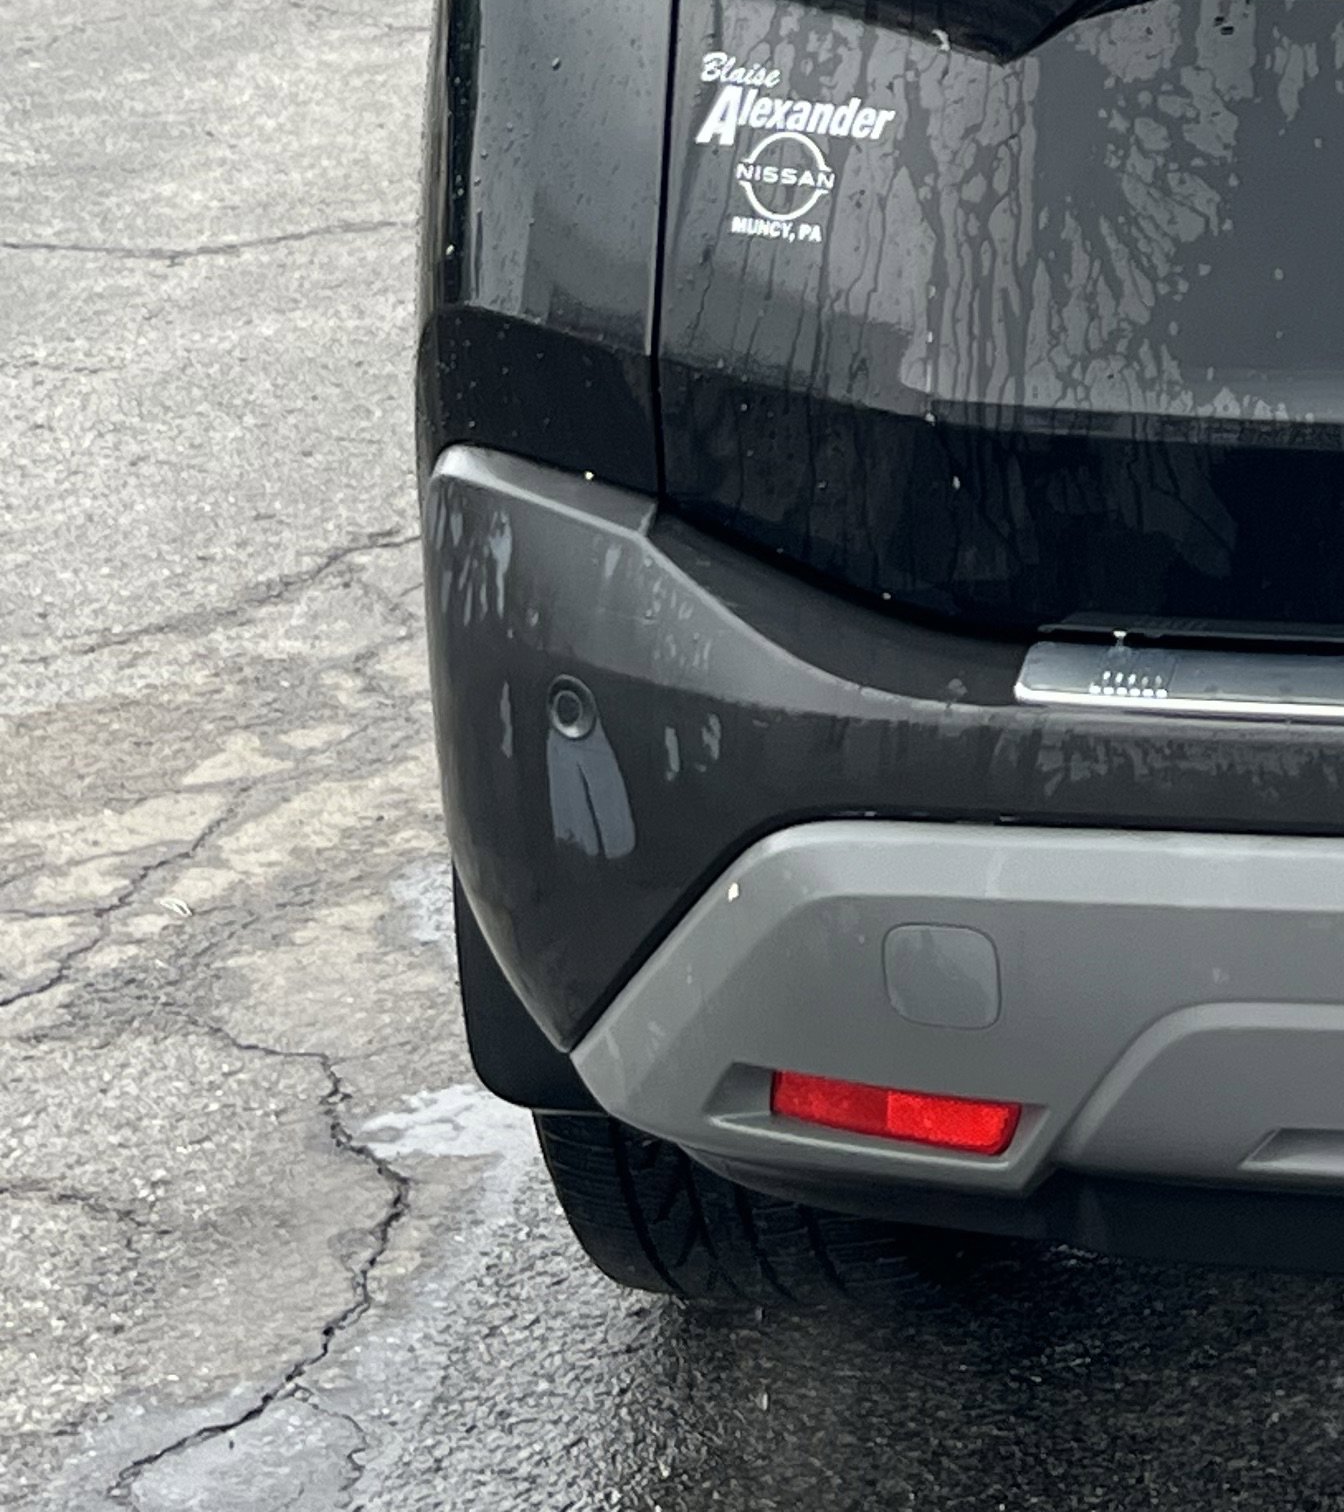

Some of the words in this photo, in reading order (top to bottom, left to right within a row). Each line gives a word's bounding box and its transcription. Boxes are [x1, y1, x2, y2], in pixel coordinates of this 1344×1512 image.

[702, 51, 780, 88] Blaise
[695, 85, 896, 145] Alexander
[737, 162, 835, 188] NISSAN
[731, 216, 795, 242] MUNCY,
[799, 223, 822, 242] PA
